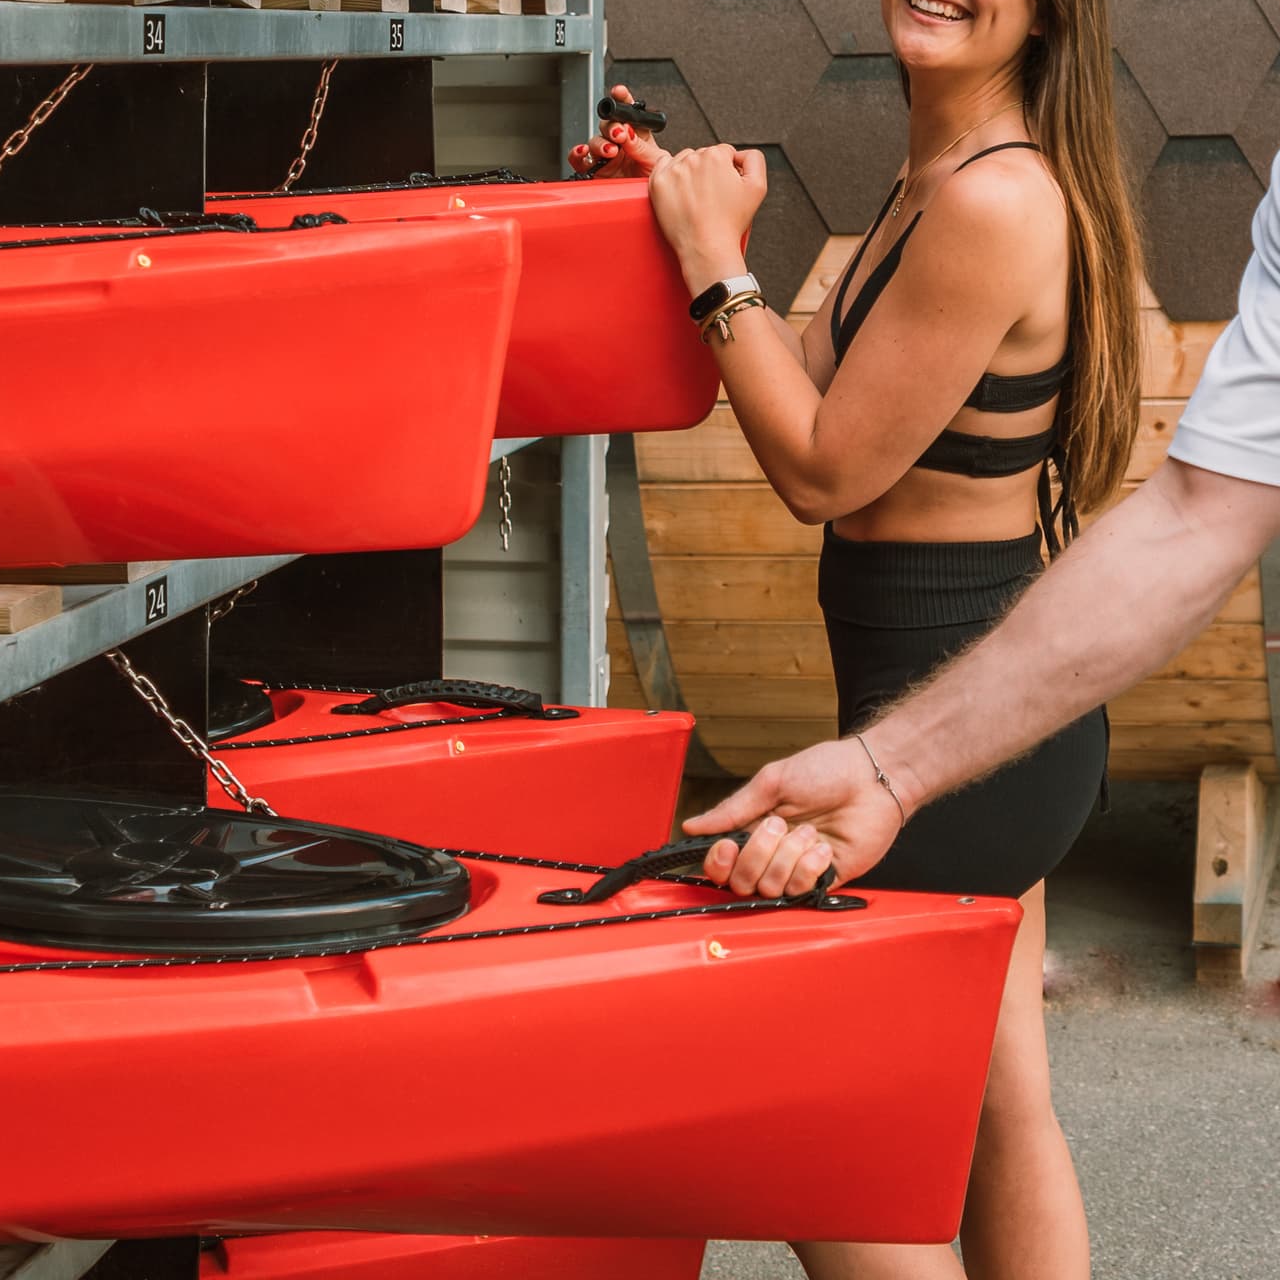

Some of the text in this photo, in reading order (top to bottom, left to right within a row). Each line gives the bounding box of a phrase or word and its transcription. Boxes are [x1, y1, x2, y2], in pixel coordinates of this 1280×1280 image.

[146, 20, 163, 50] 34
[391, 23, 403, 48] 35
[148, 584, 166, 619] 24
